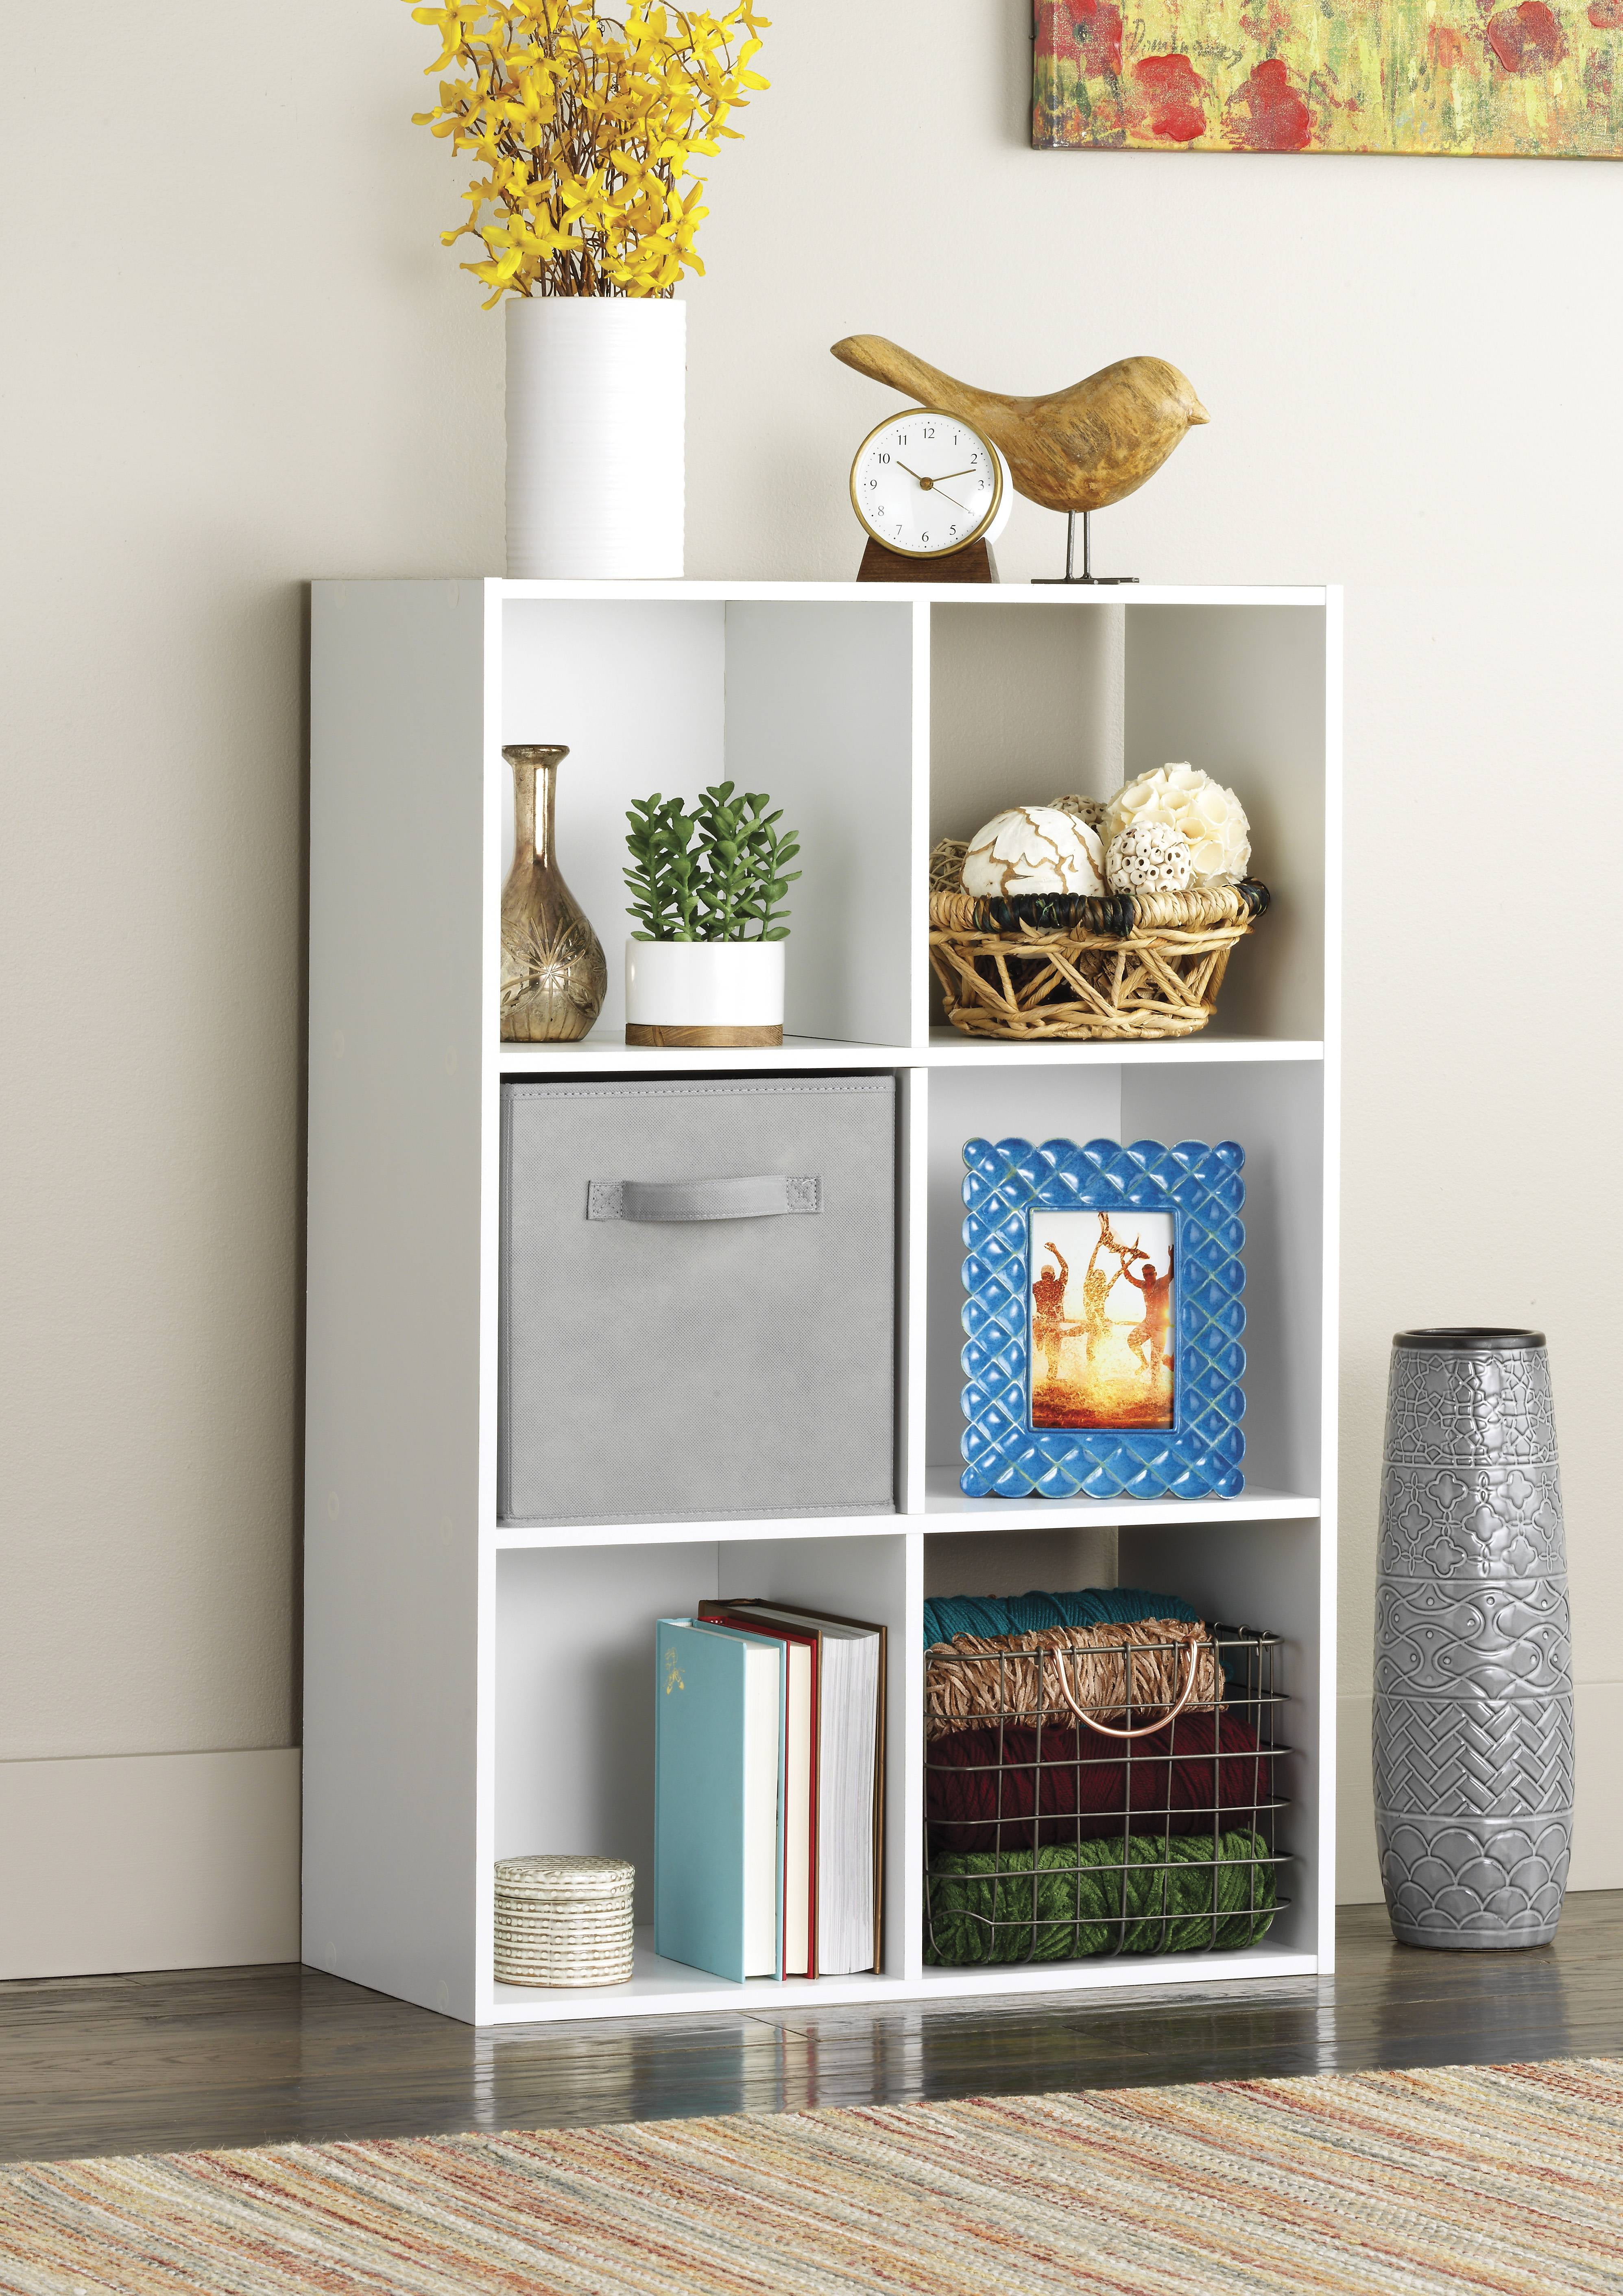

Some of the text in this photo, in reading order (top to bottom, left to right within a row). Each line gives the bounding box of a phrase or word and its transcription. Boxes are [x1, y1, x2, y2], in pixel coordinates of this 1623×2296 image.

[923, 428, 935, 439] 12
[898, 435, 907, 446] 11
[953, 435, 957, 446] 1
[878, 453, 890, 464] 10
[970, 454, 978, 464] 2
[870, 479, 877, 490] 9
[978, 480, 984, 490] 3
[877, 505, 884, 516] 8
[895, 524, 902, 535] 7
[949, 524, 956, 535] 5
[921, 531, 929, 542] 6
